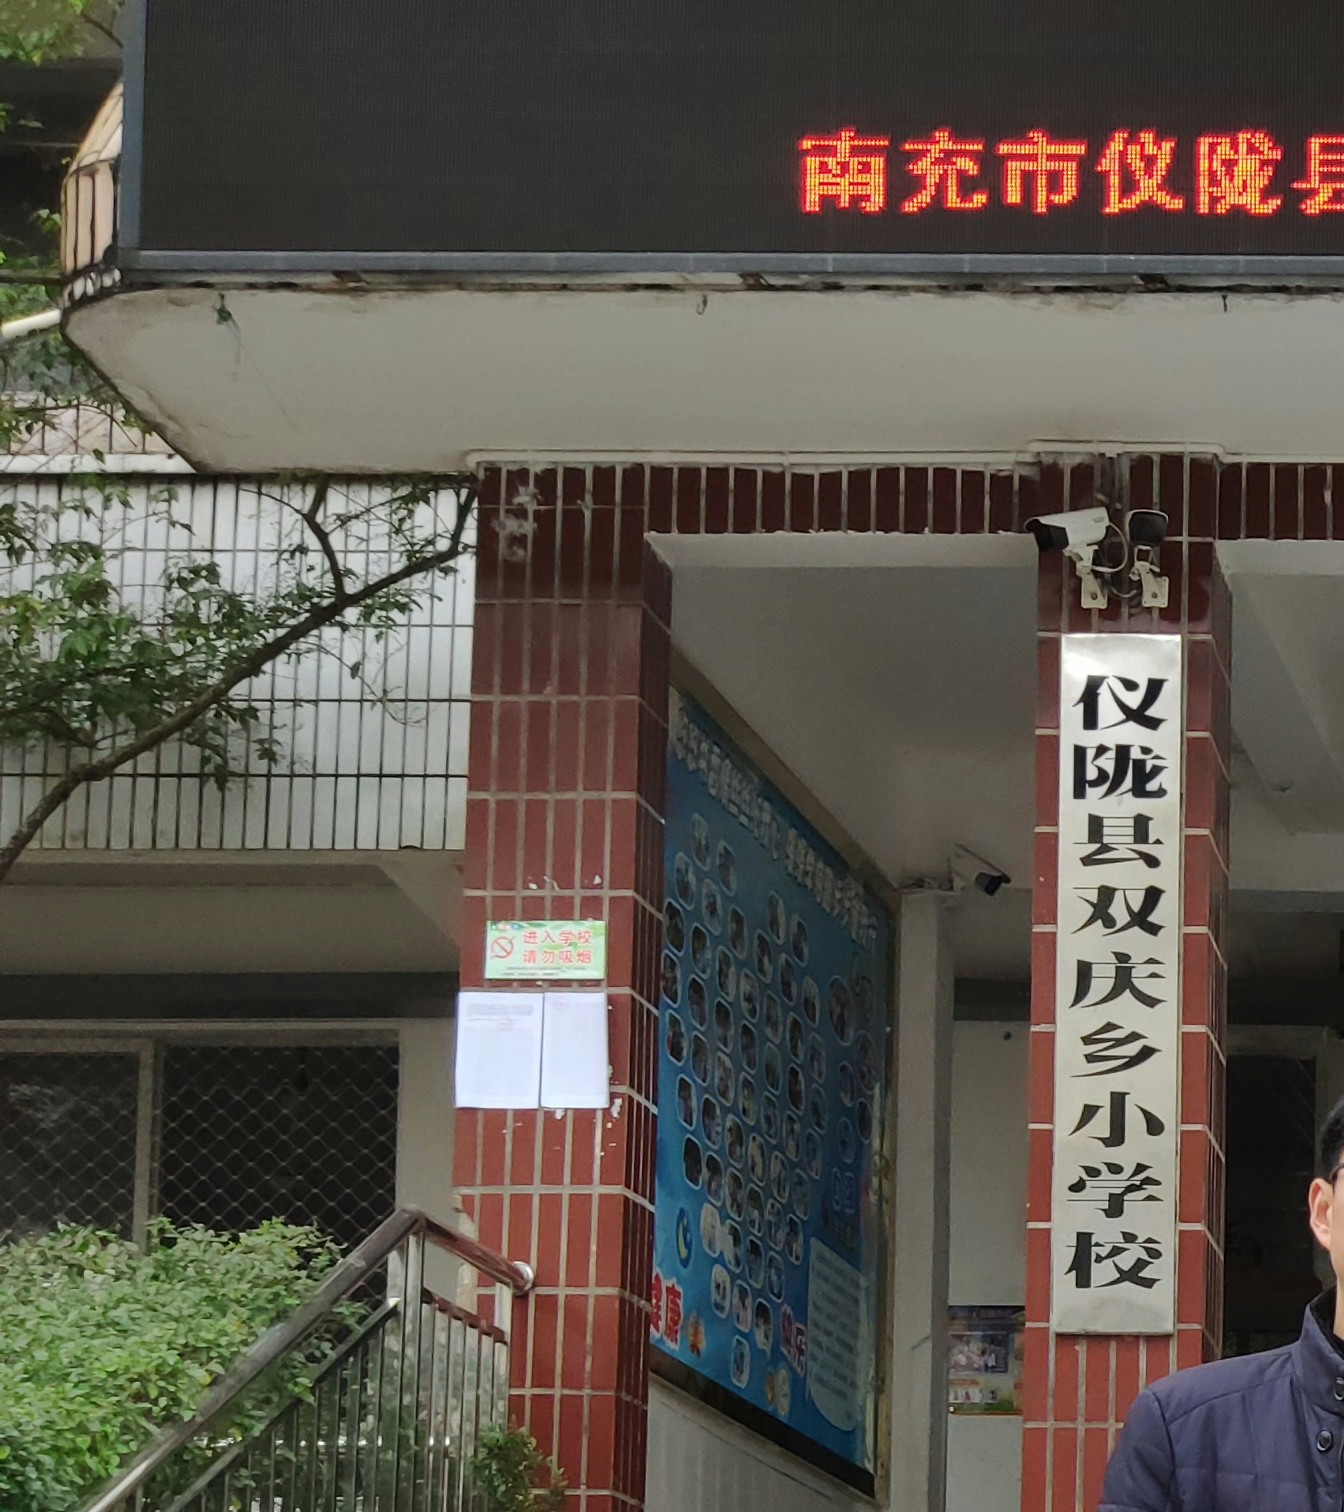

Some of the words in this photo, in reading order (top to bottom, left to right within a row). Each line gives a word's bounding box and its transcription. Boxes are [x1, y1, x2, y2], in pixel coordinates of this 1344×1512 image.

[522, 929, 593, 945] 进入学校
[522, 950, 593, 964] 请勿吸烟
[1066, 674, 1170, 1290] 仪陇县双庆乡小学校
